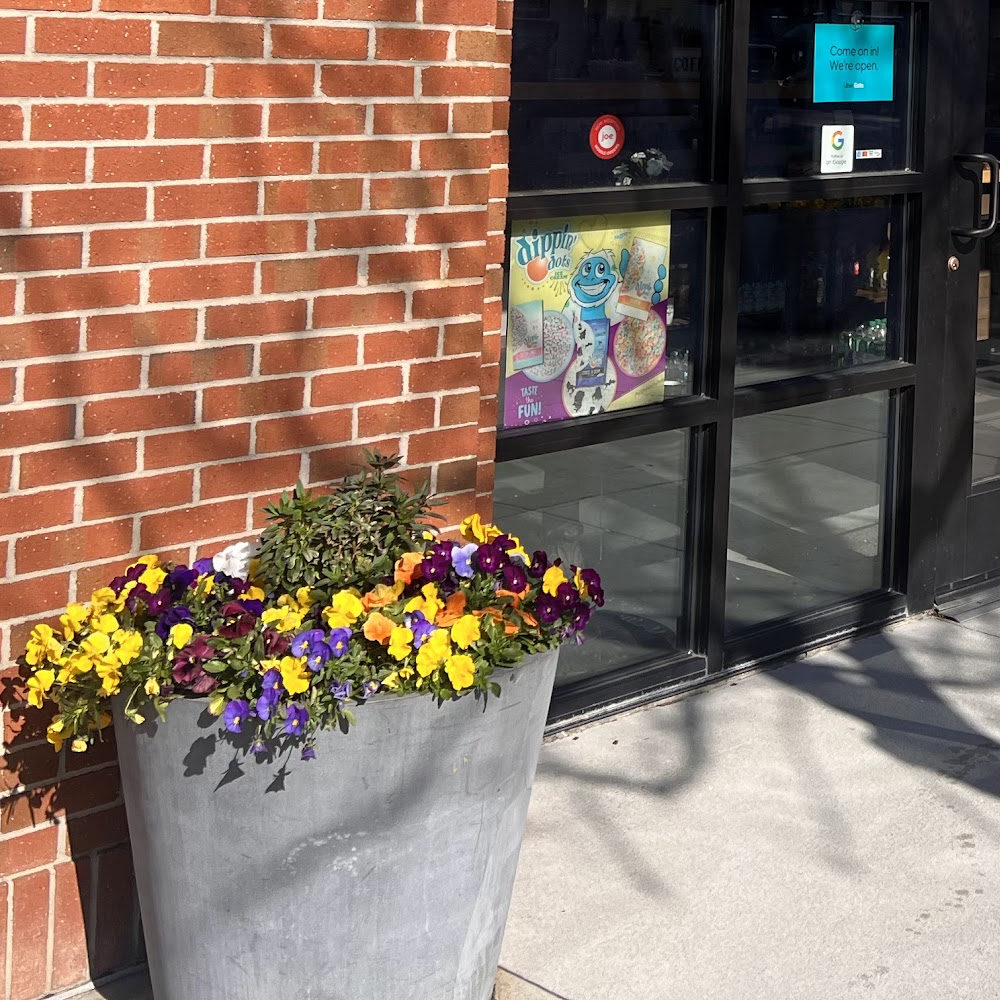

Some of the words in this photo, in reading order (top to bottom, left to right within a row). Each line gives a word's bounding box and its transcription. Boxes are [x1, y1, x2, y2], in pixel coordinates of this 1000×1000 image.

[830, 45, 856, 57] Come
[857, 48, 868, 57] on
[870, 46, 879, 56] in!
[830, 60, 853, 71] We're
[855, 62, 878, 73] open.
[601, 132, 614, 142] joe
[517, 224, 577, 265] dippin'
[548, 254, 571, 270] dots
[520, 386, 538, 397] TASTE
[518, 402, 542, 419] FUN!
